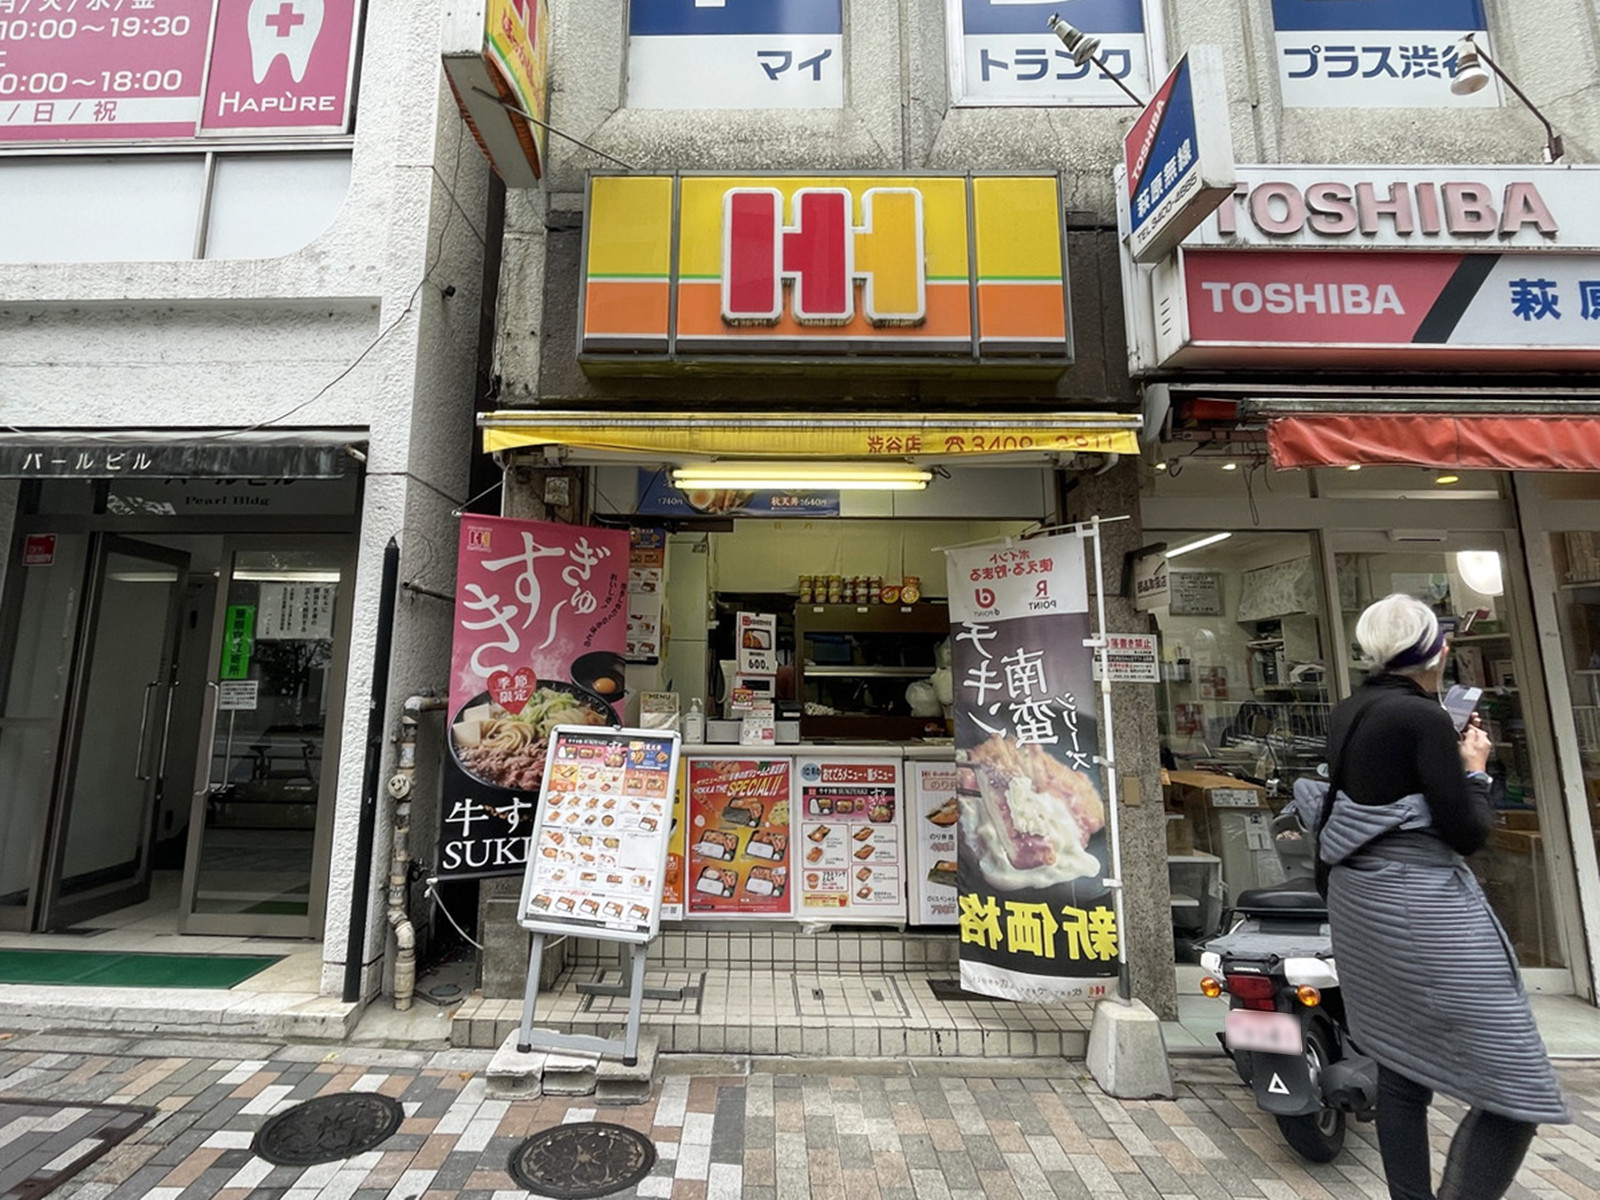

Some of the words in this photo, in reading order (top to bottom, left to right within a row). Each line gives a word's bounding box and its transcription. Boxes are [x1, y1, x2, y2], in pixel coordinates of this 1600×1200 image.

[757, 48, 832, 81] マイ
[1131, 99, 1166, 181] TOSHIBA
[1217, 181, 1558, 237] TOSHIBA
[1202, 282, 1405, 315] TOSHIBA
[867, 435, 922, 454] 渋谷店
